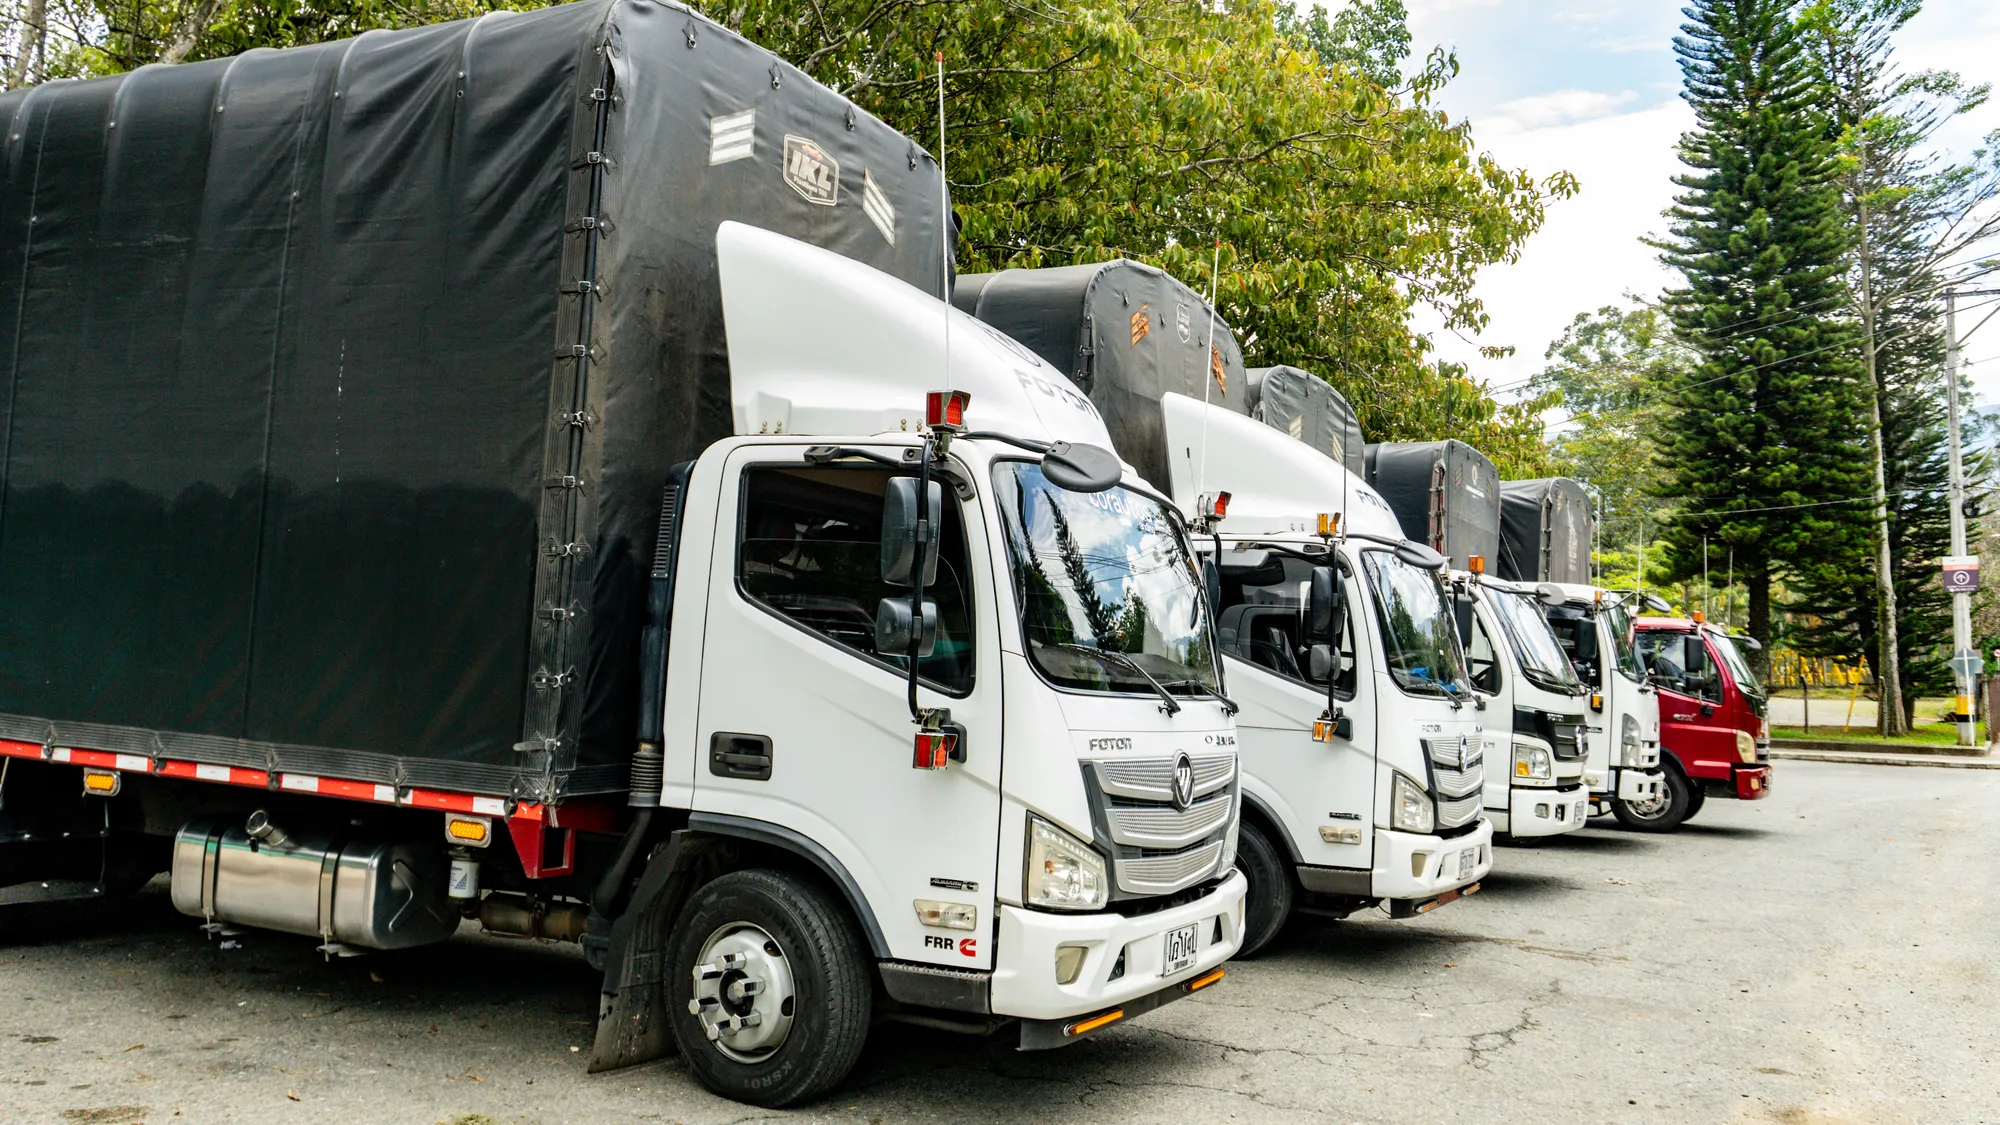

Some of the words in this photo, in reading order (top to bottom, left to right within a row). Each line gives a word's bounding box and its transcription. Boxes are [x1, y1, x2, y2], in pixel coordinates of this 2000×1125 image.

[790, 150, 831, 191] IKL
[1013, 368, 1099, 420] FOTON
[1089, 737, 1132, 750] FOTON
[924, 935, 954, 951] FRR
